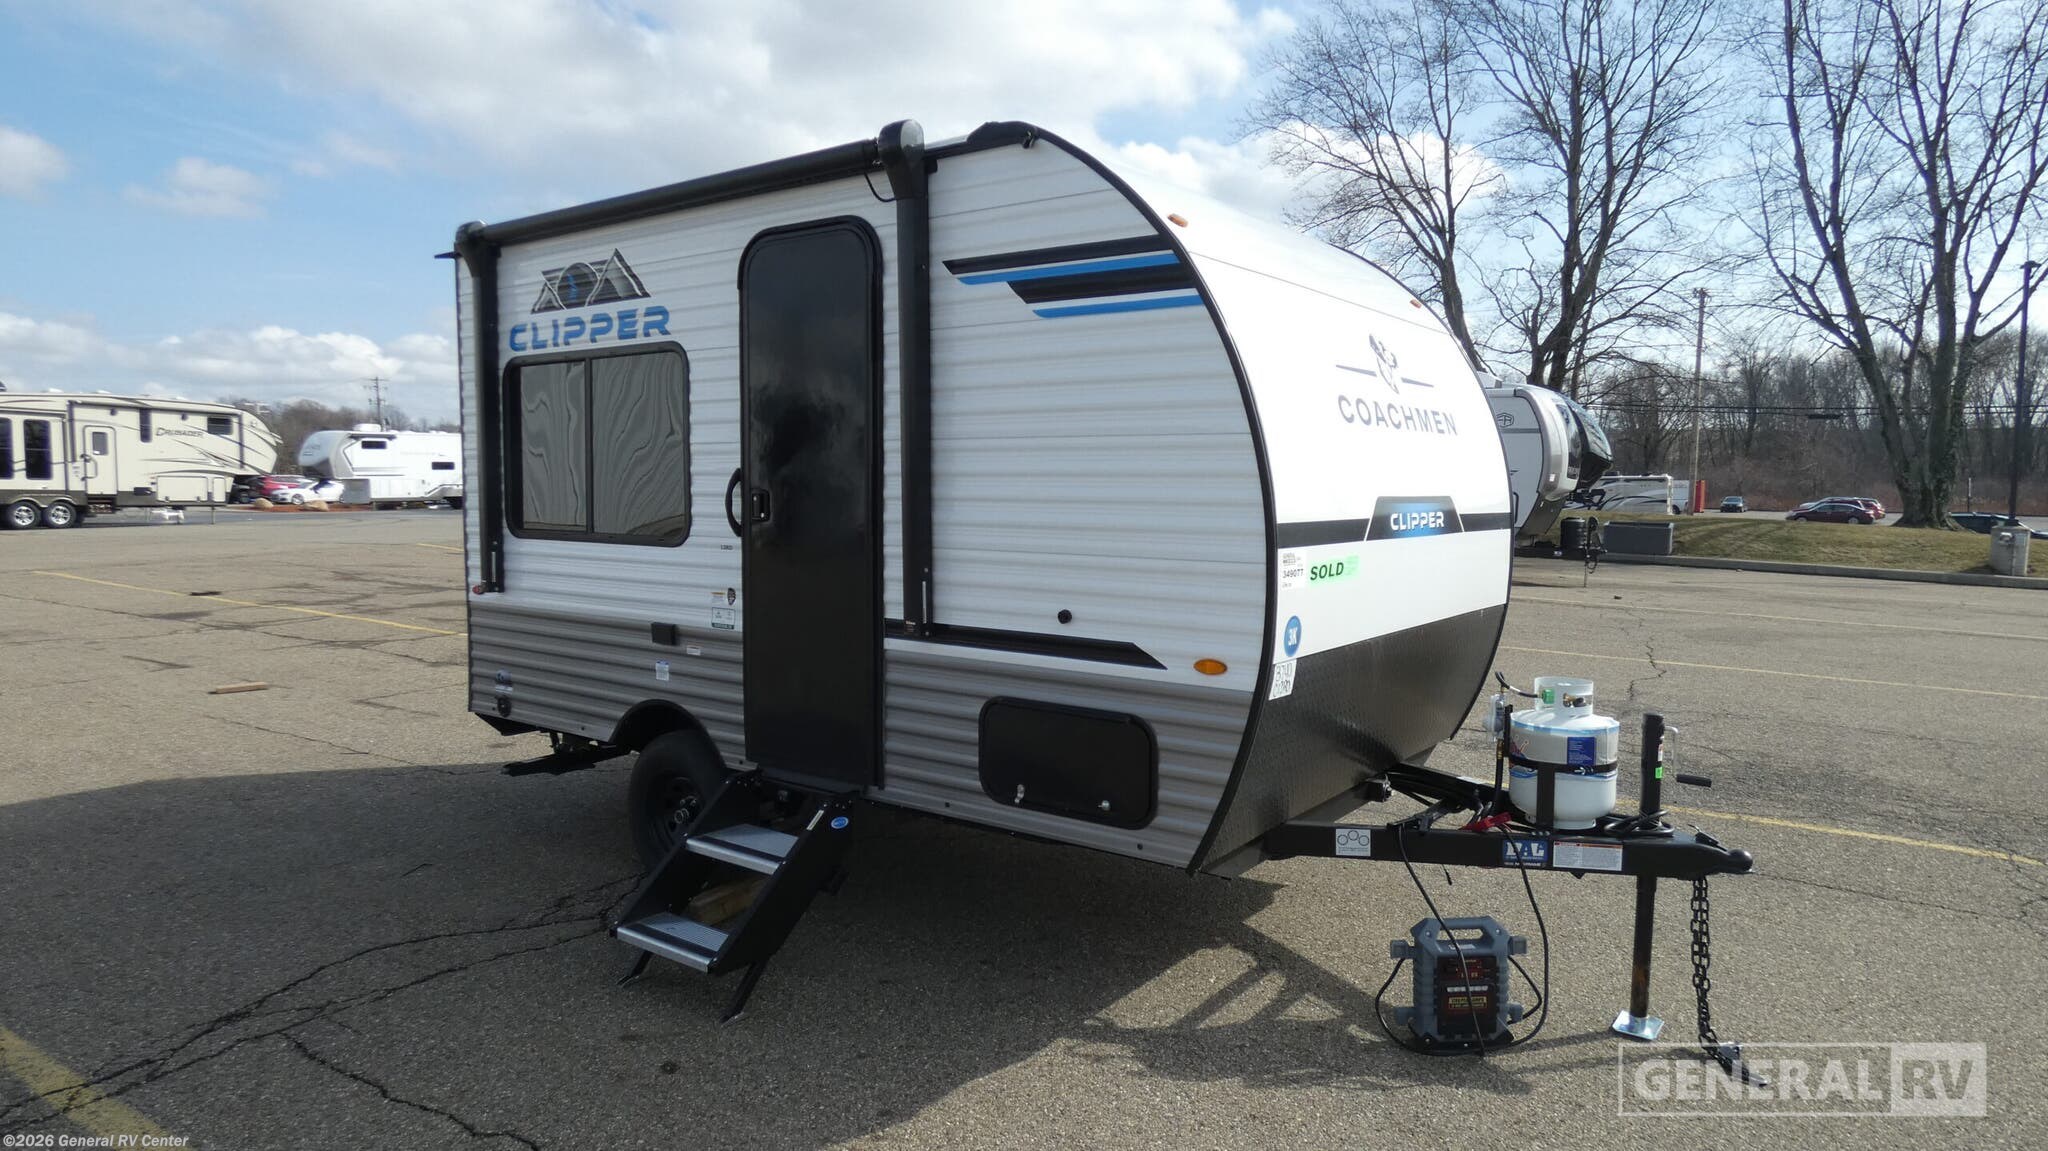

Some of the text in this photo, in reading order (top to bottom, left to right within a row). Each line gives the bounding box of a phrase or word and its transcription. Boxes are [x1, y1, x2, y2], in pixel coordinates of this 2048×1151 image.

[510, 307, 672, 351] CLIPPER
[1337, 394, 1458, 436] COACHMEN
[1391, 512, 1445, 531] CLIPPER
[1310, 562, 1344, 581] SOLD
